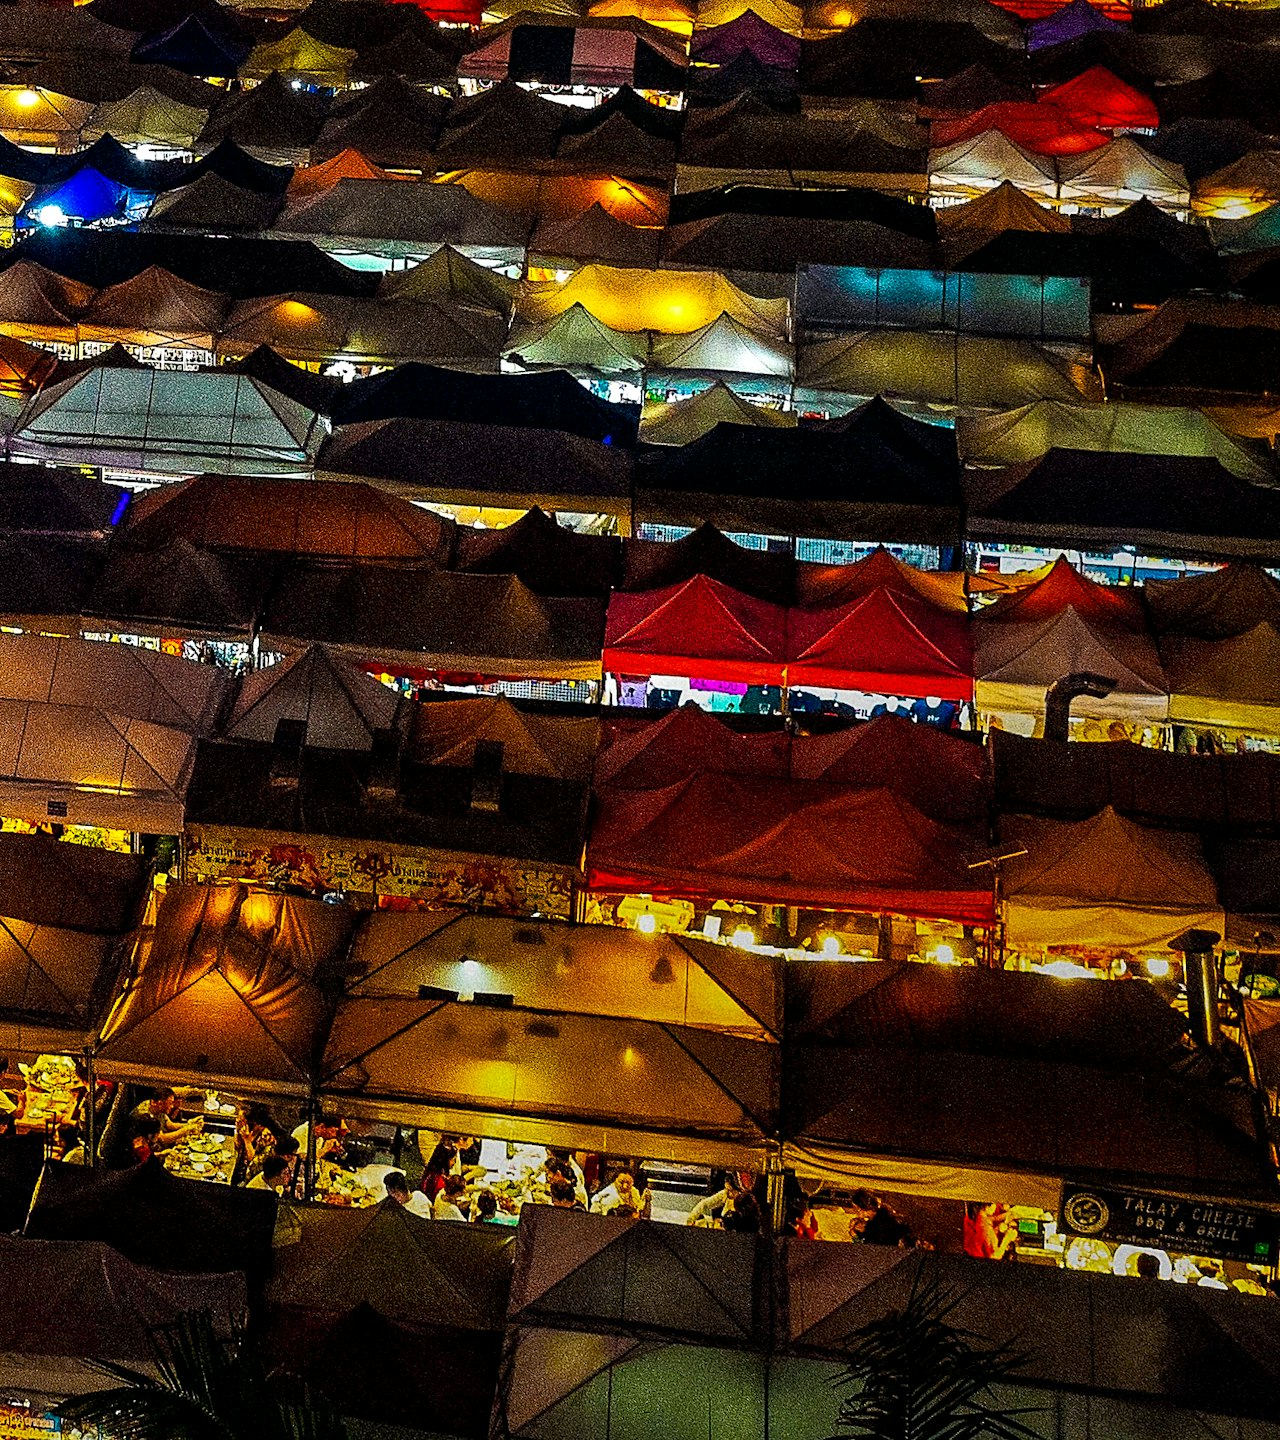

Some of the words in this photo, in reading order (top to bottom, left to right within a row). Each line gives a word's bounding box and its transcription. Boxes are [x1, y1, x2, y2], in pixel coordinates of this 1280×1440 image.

[1122, 1196, 1181, 1218] TALAY
[1191, 1206, 1257, 1229] CHEESE
[1196, 1224, 1240, 1242] GRILL
